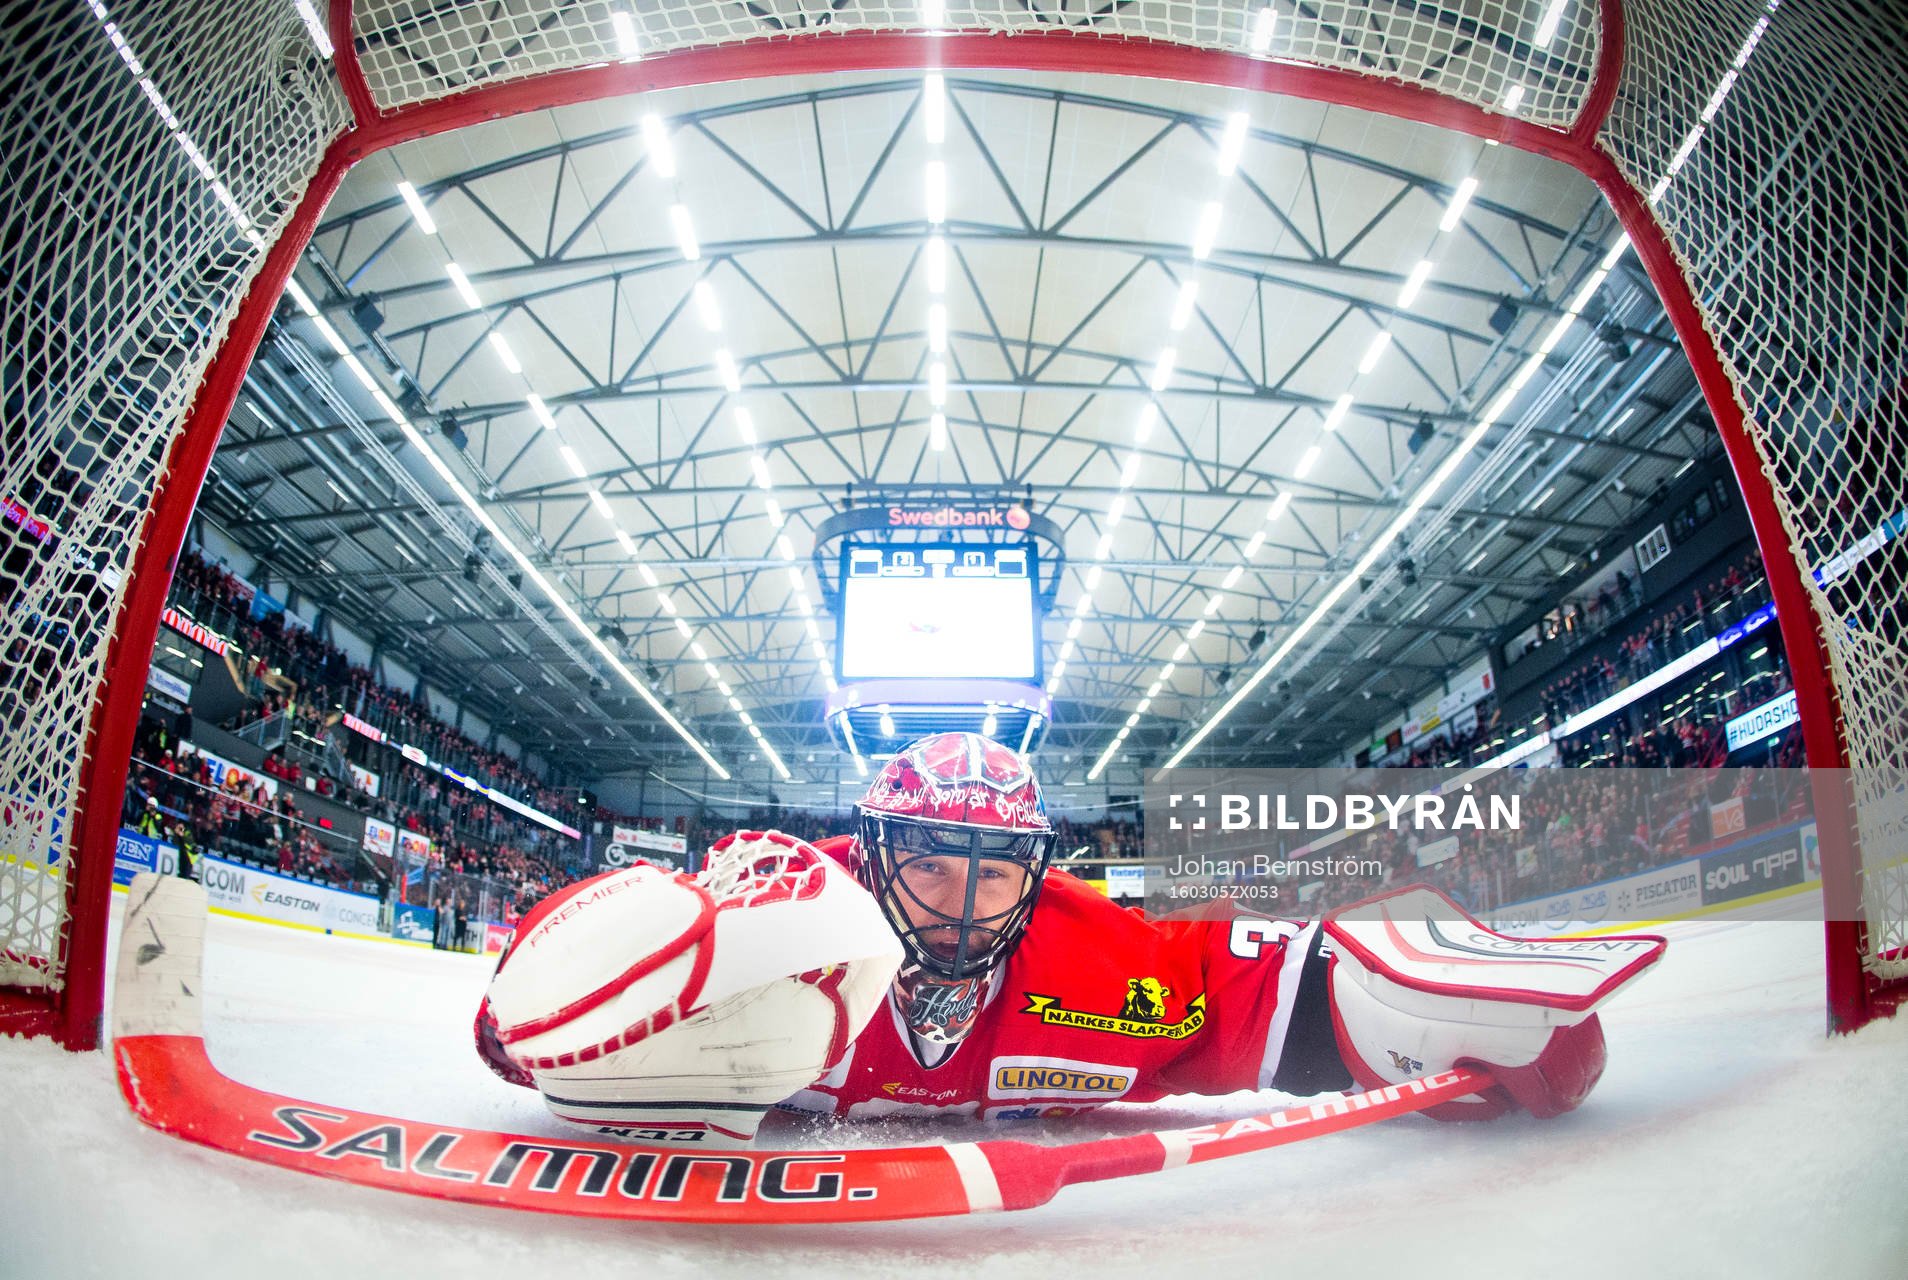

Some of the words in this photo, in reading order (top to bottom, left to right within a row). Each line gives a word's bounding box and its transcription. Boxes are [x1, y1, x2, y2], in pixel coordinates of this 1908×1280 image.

[889, 507, 1003, 526] Swedbank
[1636, 874, 1697, 902] PISCATOR
[1706, 863, 1750, 891] SOUL
[265, 891, 320, 912] EASTON
[531, 876, 644, 947] PREMIER
[1468, 934, 1650, 952] CONCENT
[1048, 1009, 1115, 1029] NÄRKES
[1184, 1015, 1203, 1034] AB
[1002, 1066, 1124, 1091] LINOTOL
[898, 1087, 957, 1100] EASTON
